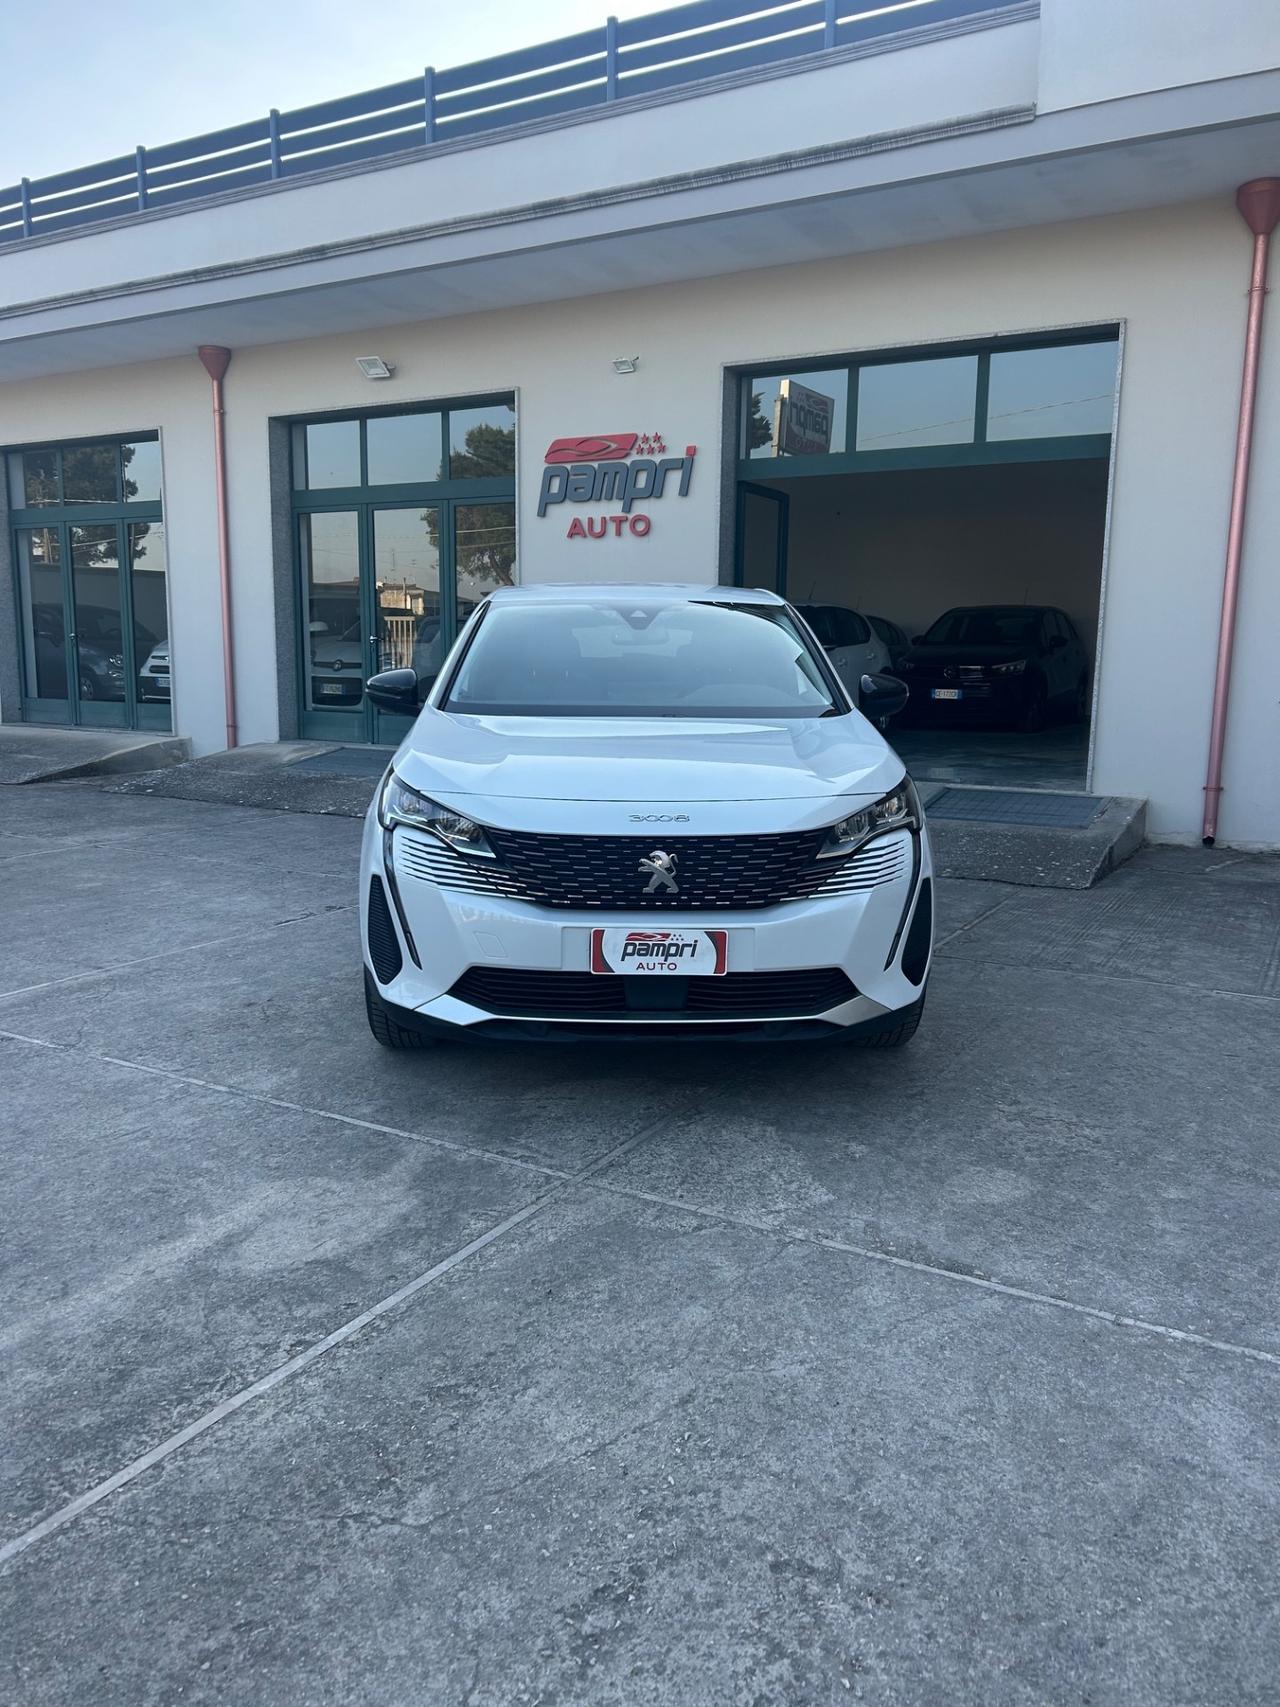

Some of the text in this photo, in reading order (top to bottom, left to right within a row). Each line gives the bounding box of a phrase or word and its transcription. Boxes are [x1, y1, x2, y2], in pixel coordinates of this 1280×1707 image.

[537, 445, 697, 517] pampri
[566, 514, 651, 538] AUTO
[629, 814, 690, 822] 3008
[620, 940, 698, 962] pampri
[636, 962, 677, 971] AUTO
